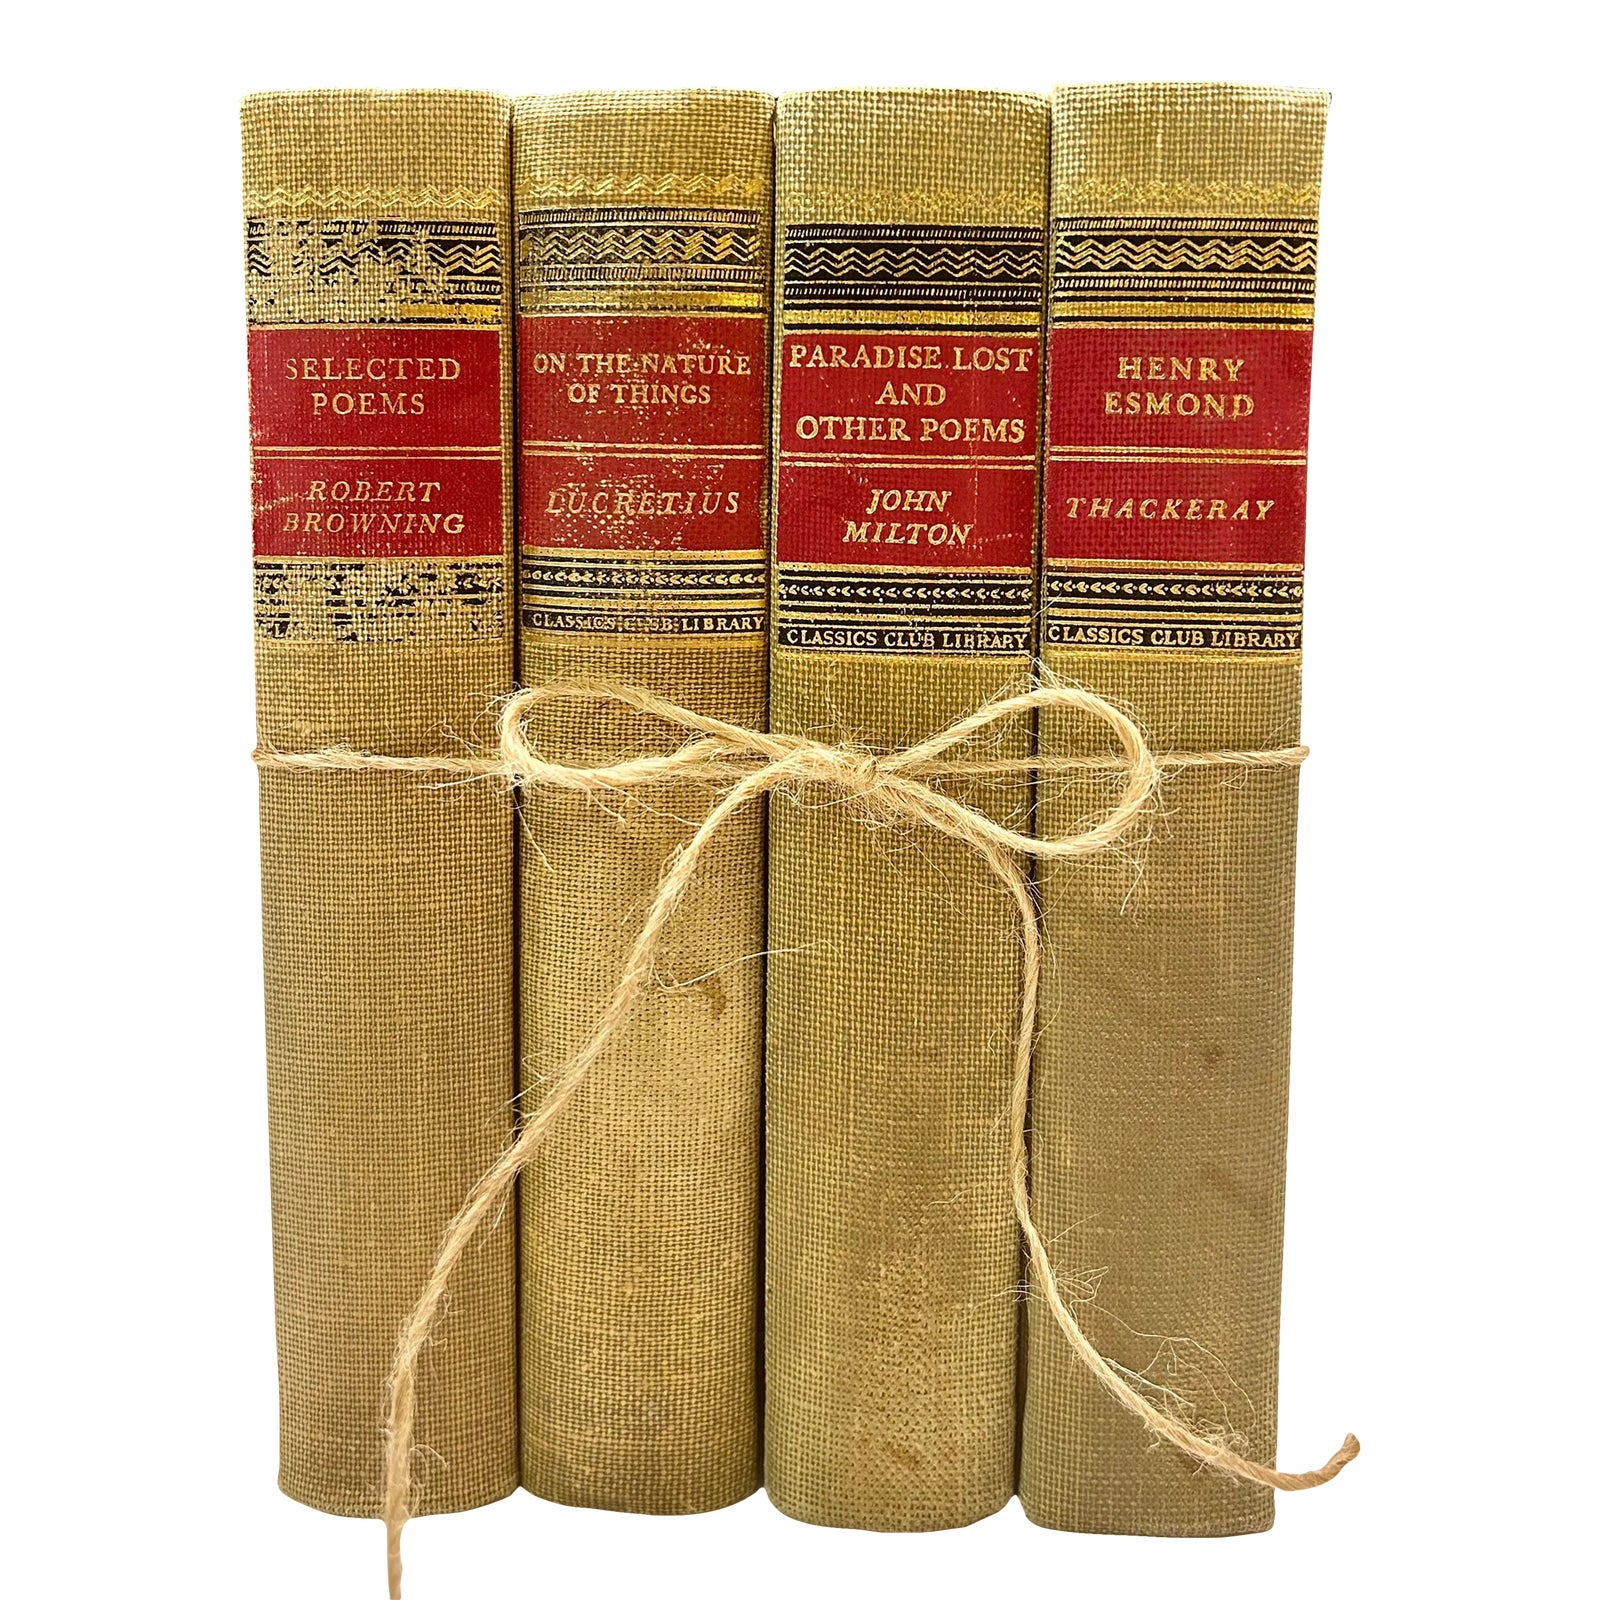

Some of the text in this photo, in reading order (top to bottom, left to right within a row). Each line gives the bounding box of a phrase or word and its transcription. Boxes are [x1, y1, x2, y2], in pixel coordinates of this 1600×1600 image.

[285, 357, 461, 380] SELECTED
[533, 353, 752, 376] ON THE NATURE
[789, 344, 1034, 372] PARADISE LOST
[1117, 356, 1245, 381] HENRY
[312, 392, 425, 415] POEMS
[567, 383, 712, 405] OF THINGS
[874, 381, 947, 406] AND
[1104, 392, 1254, 418] ESMOND
[795, 415, 1026, 443] OTHER POEMS
[305, 480, 441, 502] ROBERT
[866, 489, 952, 514] JOHN
[545, 491, 740, 516] LUCRETIUS
[1065, 497, 1275, 521] THACKERAY
[282, 512, 466, 534] BROWNING
[842, 521, 974, 546] MILTON
[532, 612, 616, 631] CLASSICS
[681, 616, 765, 631] LIBRARY
[786, 629, 1028, 650] CLASSICS CLUB LIBRARY
[1047, 626, 1299, 648] CLASSICS CLUB LIBRARY
